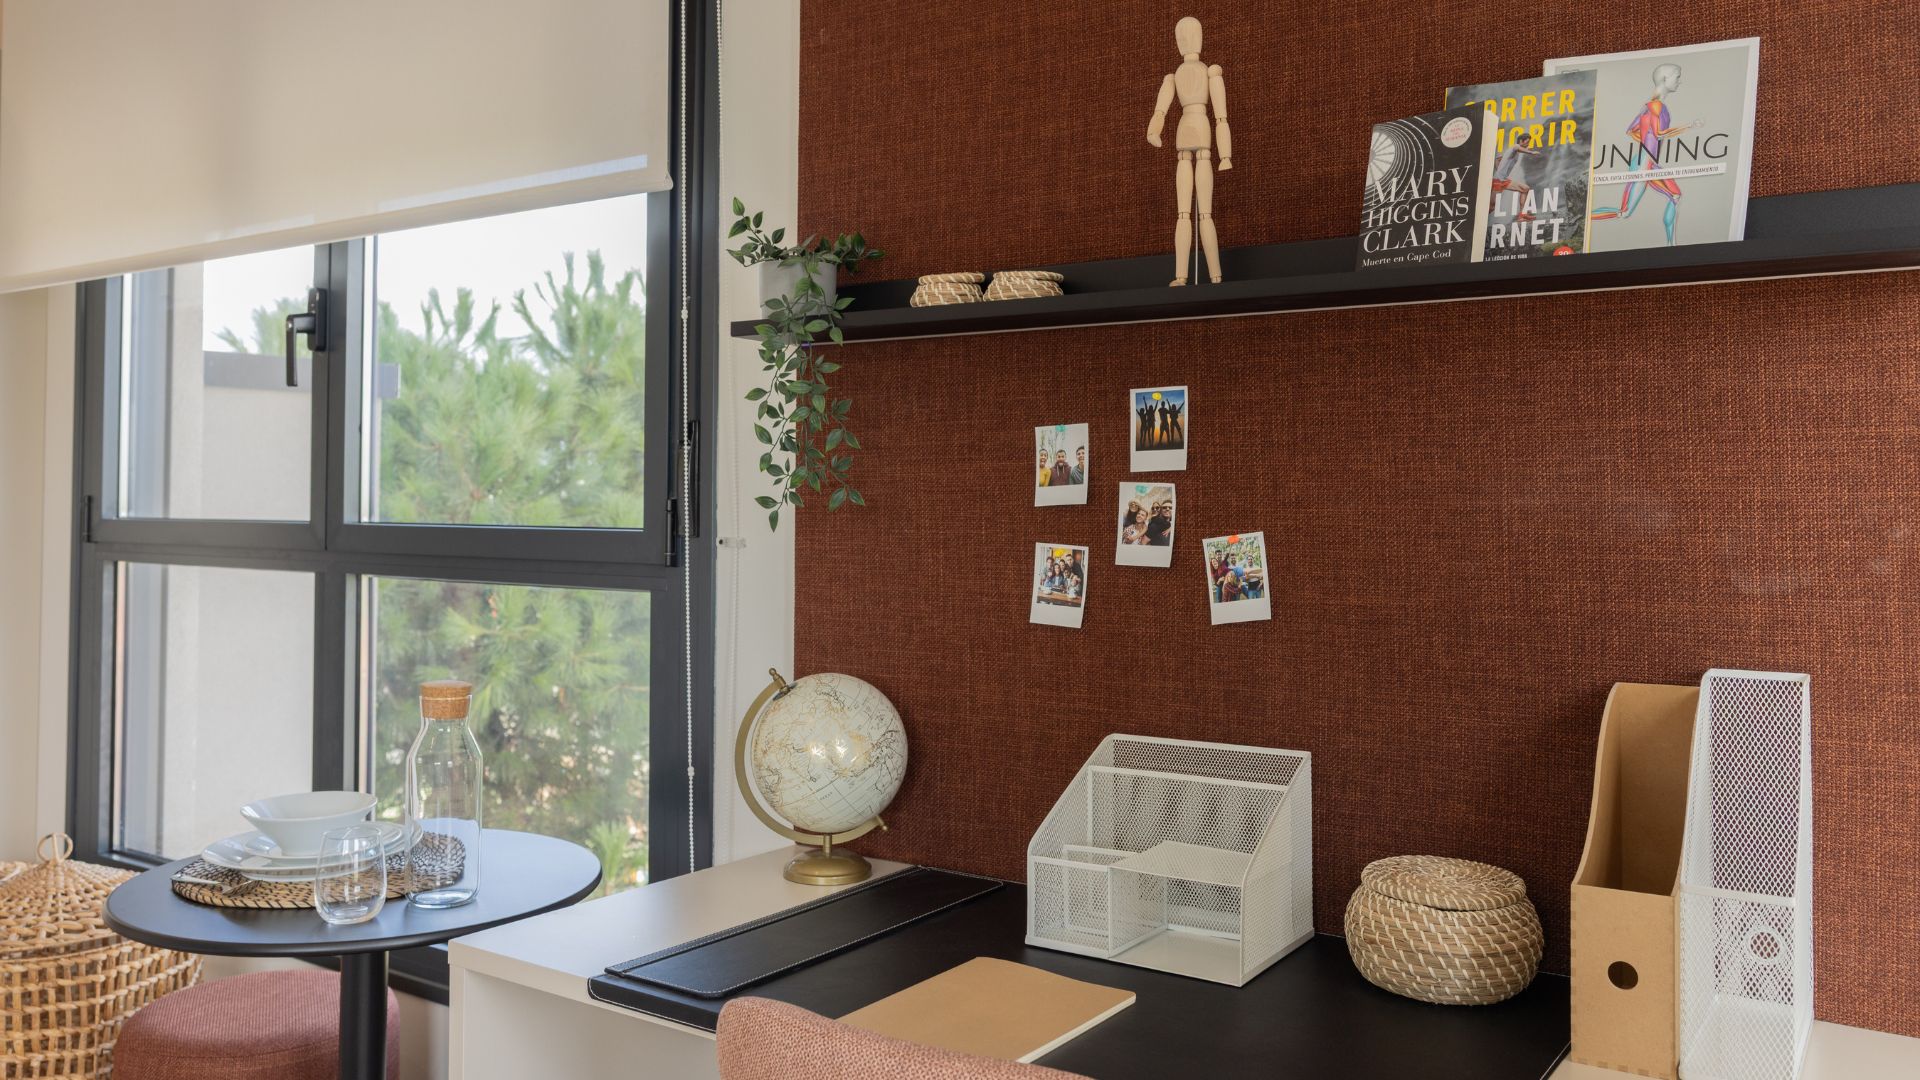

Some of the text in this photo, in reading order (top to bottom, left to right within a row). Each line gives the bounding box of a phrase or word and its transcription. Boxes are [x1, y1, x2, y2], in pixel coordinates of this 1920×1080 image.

[1465, 88, 1576, 122] ORRER
[1497, 119, 1577, 153] ORIR
[1593, 133, 1729, 169] UNNING
[1369, 165, 1473, 206] MARY
[1494, 187, 1559, 217] LIAN
[1366, 196, 1469, 228] HIGGINS
[1363, 219, 1467, 253] CLARK
[1490, 218, 1564, 249] RNET
[1362, 248, 1452, 267] Muerte en Cape Cod
